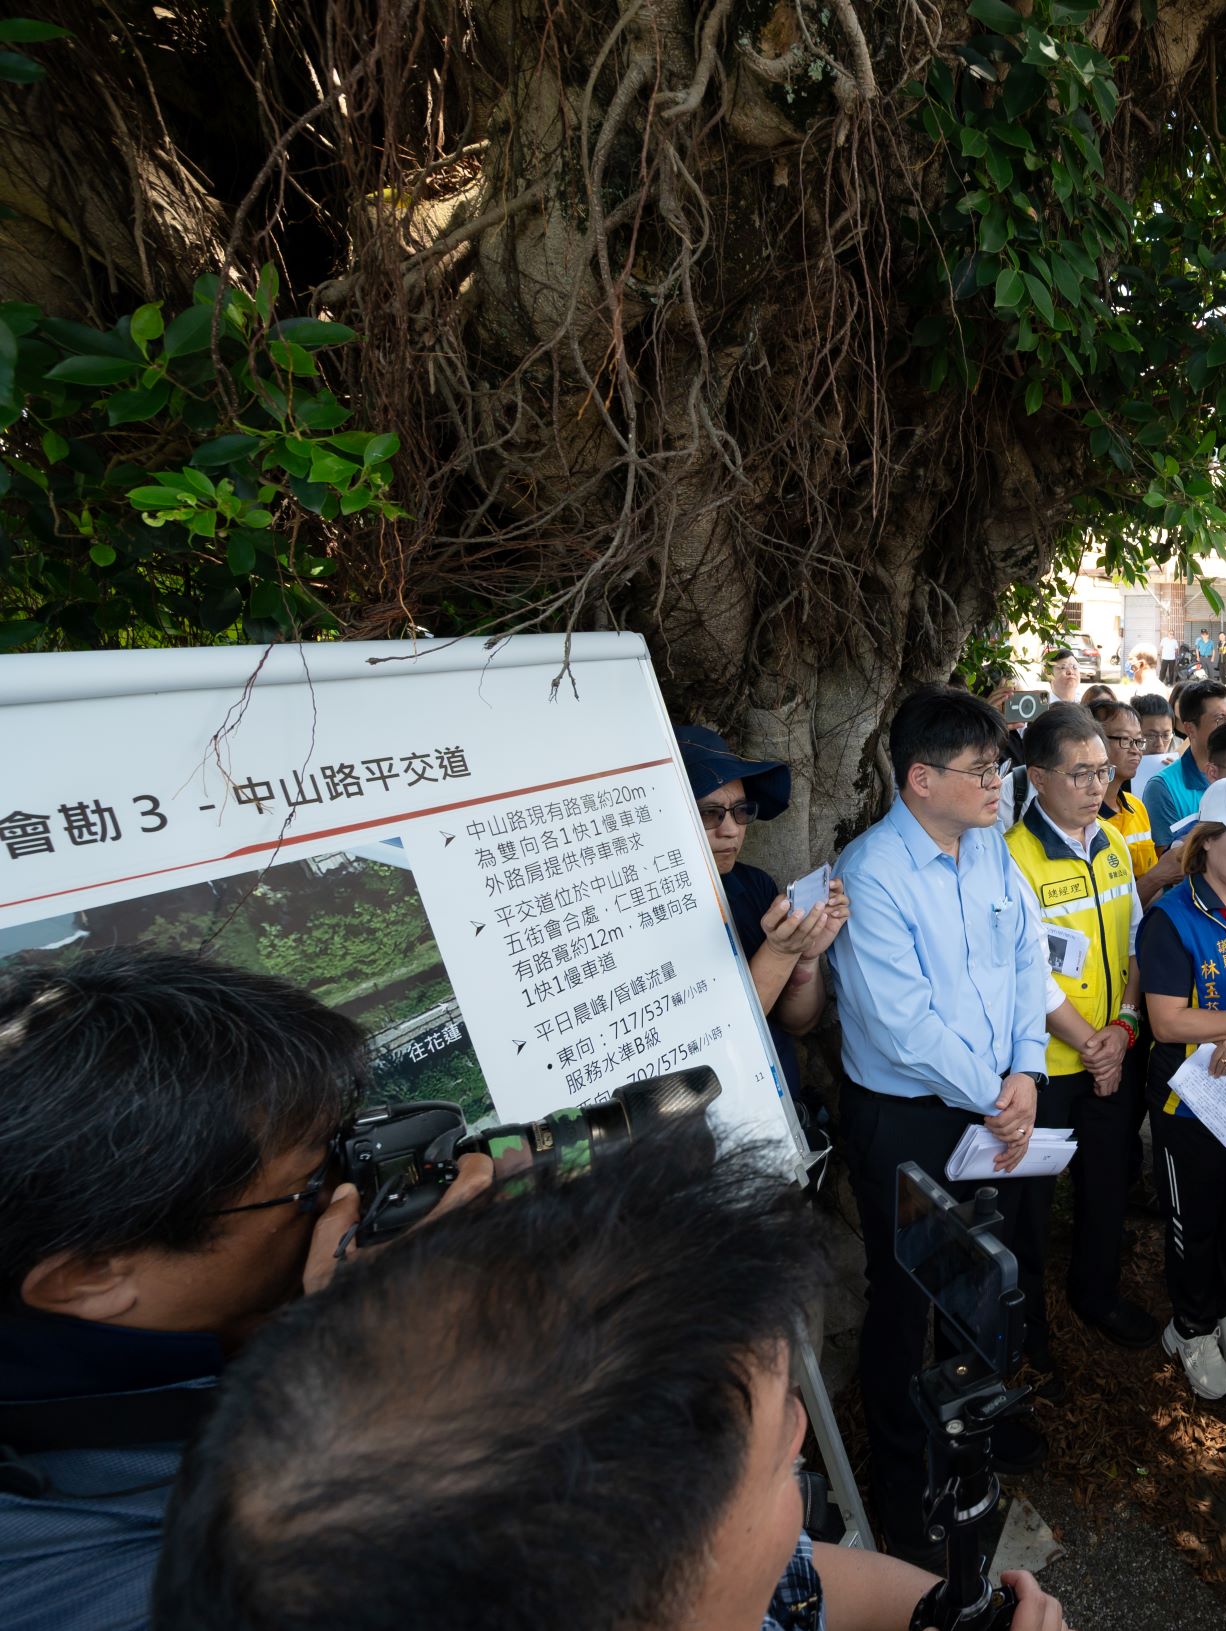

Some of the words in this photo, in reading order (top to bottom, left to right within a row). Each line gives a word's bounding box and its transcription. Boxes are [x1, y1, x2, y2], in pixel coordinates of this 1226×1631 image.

[0, 800, 122, 859] 會勘
[132, 795, 168, 833] 3
[233, 745, 472, 814] 中山路平交道
[485, 831, 644, 898] 外路肩提供停車需求
[1048, 883, 1081, 898] 總經理
[521, 951, 617, 1008] 1快1慢車道
[534, 960, 677, 1042] 平日晨峰/昏峰流量
[407, 1021, 462, 1063] 往花蓮
[565, 1026, 662, 1095] 服務水準B級
[754, 1071, 765, 1083] 11
